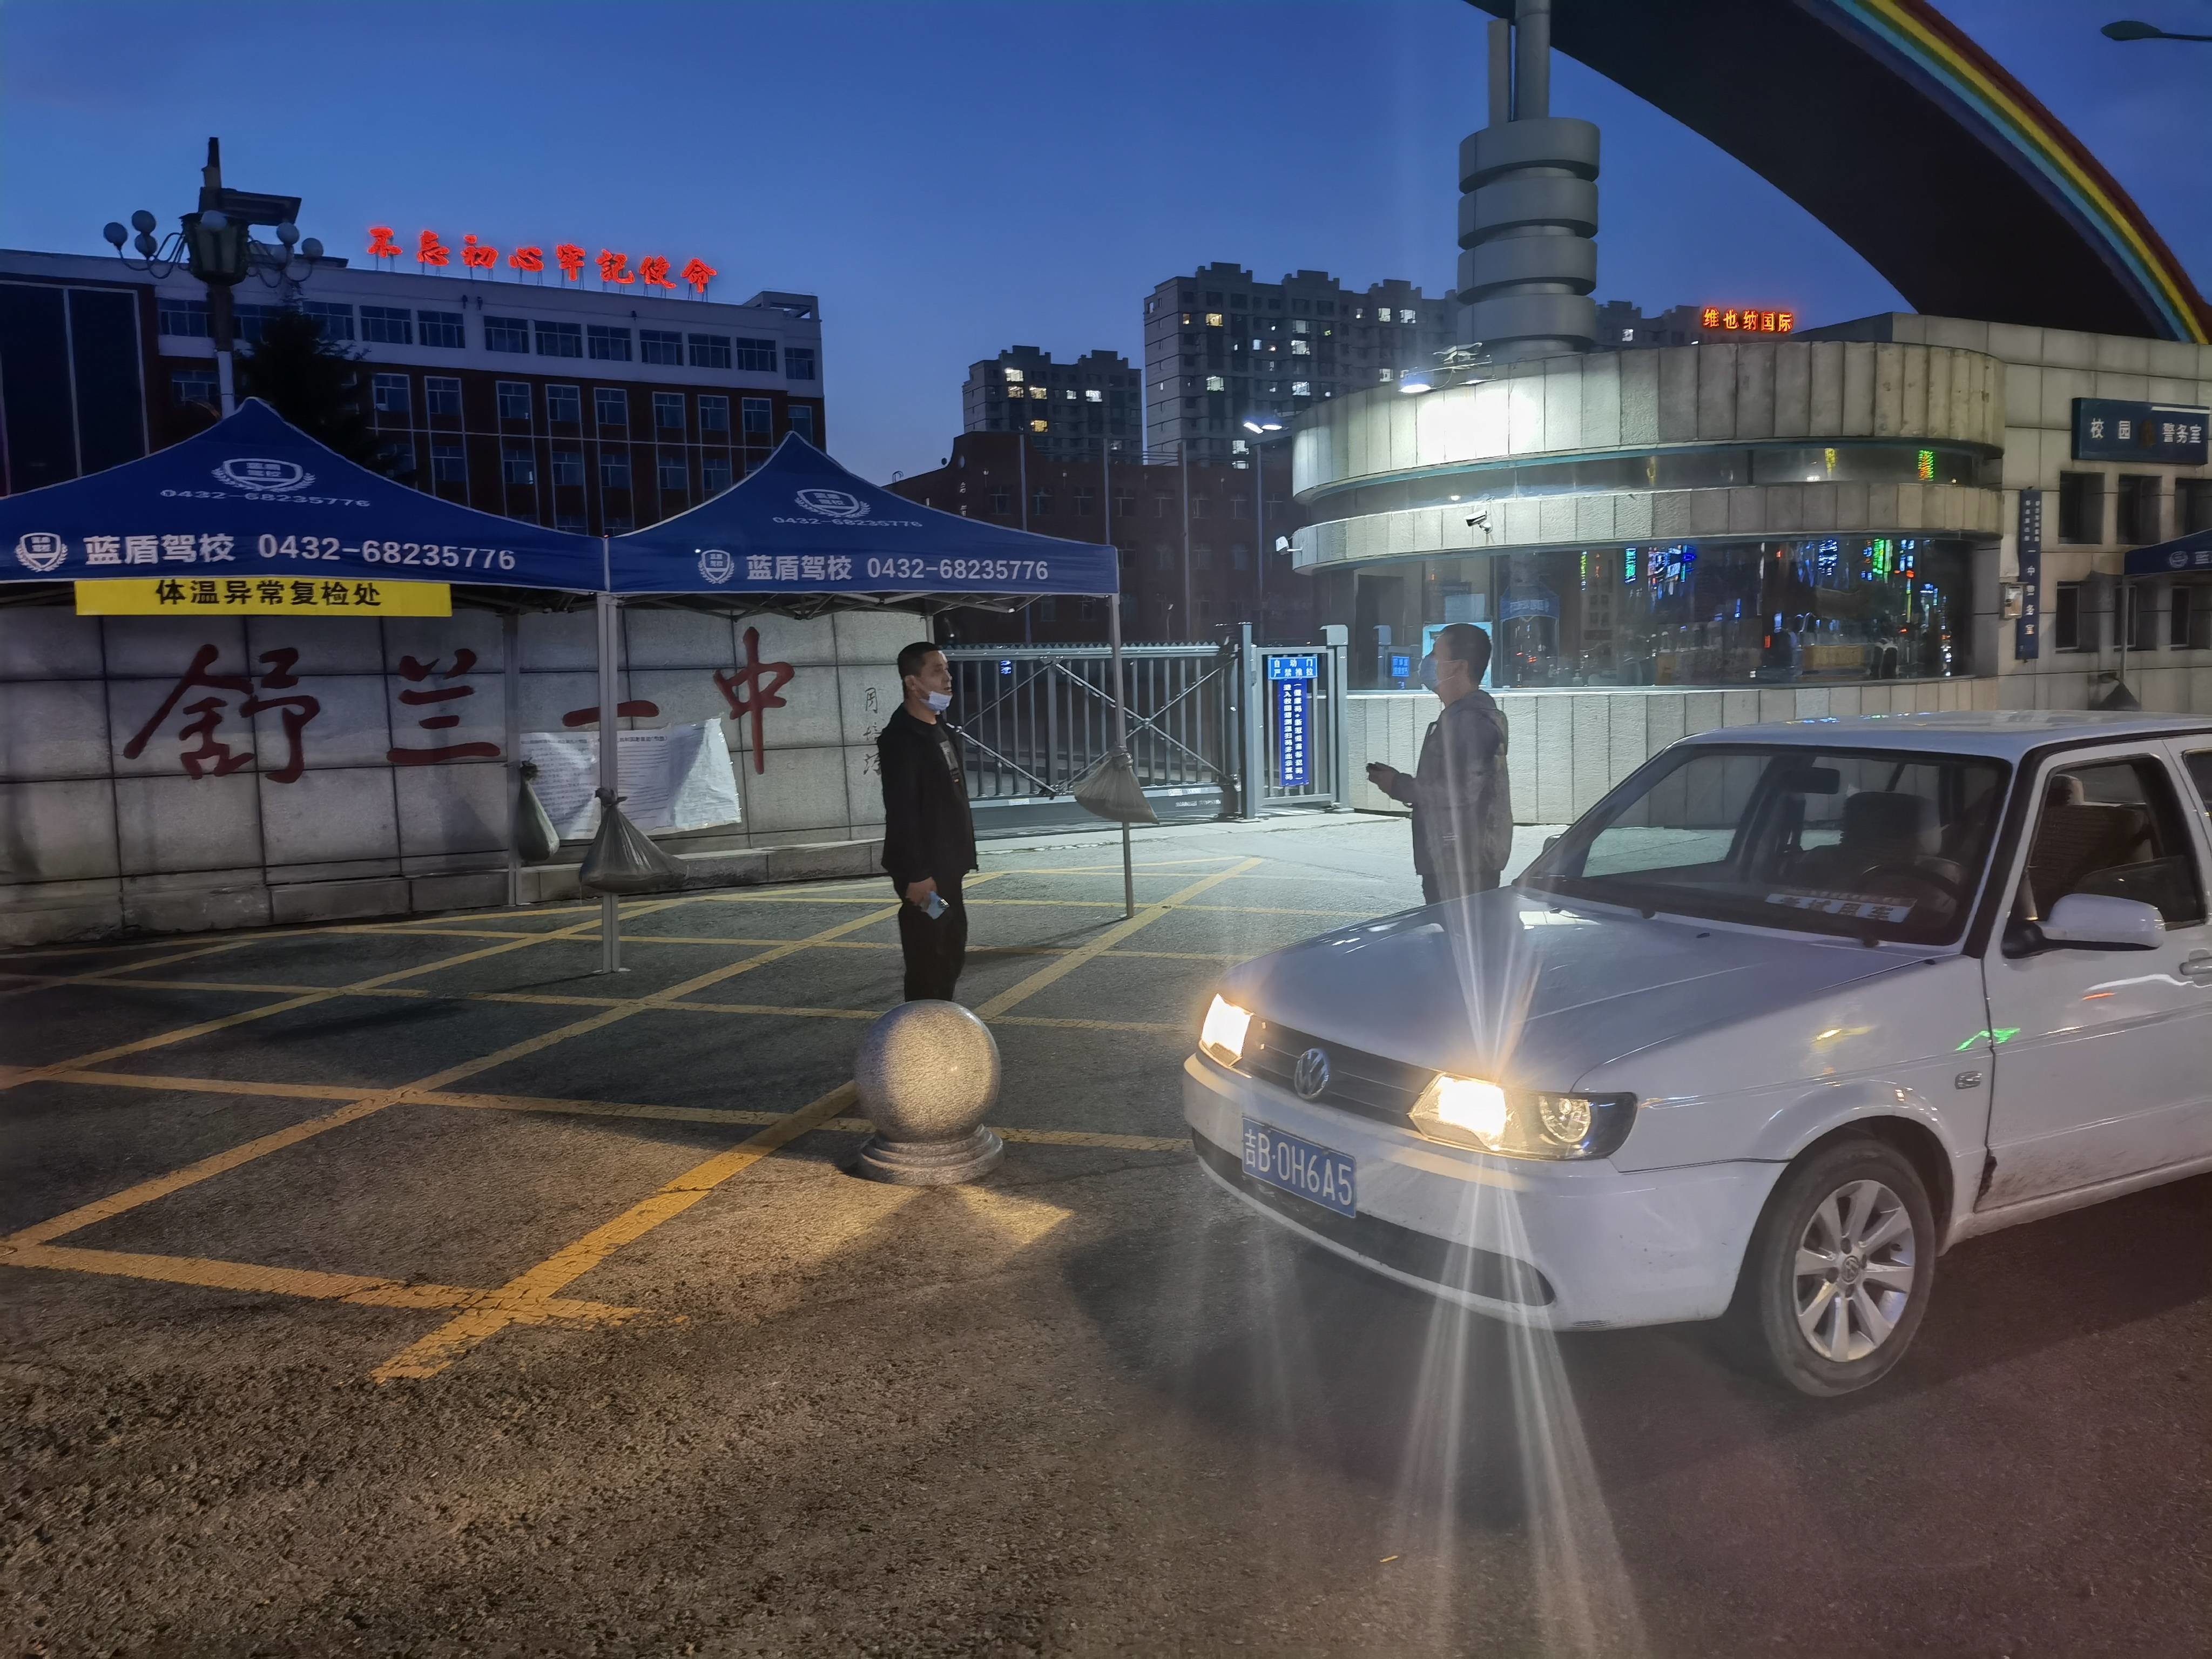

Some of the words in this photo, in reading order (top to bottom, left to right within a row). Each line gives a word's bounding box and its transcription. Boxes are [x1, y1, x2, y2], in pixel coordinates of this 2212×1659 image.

[1703, 307, 1793, 333] 维也纳国际
[2162, 422, 2202, 443] 警务室
[160, 489, 370, 507] 0432-68235776
[83, 533, 236, 565] 蓝盾驾校
[258, 534, 516, 570] 0432-68235776
[746, 554, 853, 581] 蓝盾驾校
[867, 557, 1049, 580] 0432-68235776
[156, 579, 381, 606] 体温异常复检处
[123, 626, 795, 784] 舒兰一中
